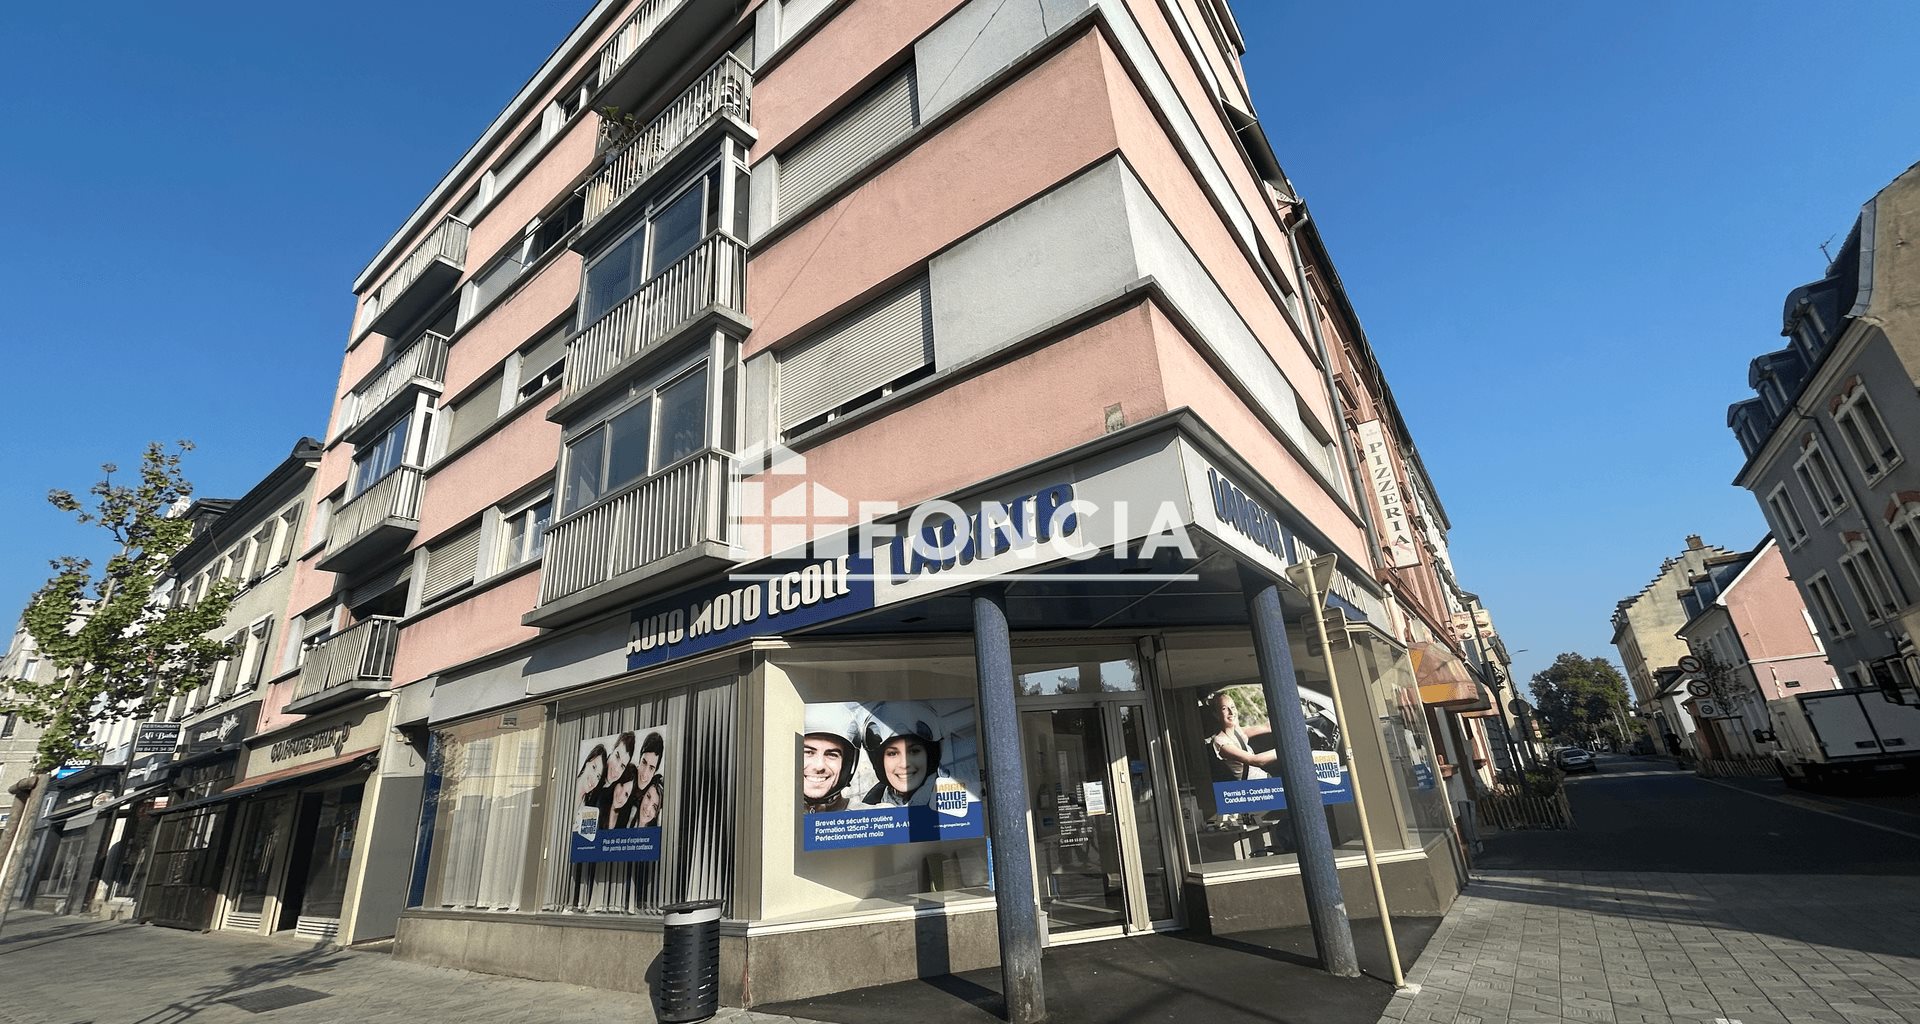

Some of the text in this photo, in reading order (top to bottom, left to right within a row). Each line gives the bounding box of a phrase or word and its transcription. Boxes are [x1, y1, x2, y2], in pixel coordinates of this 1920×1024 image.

[1369, 441, 1410, 547] PIZZERIA
[626, 608, 684, 656] AUTO
[689, 584, 761, 638] MOTO
[767, 554, 851, 616] ECOLE
[139, 731, 177, 740] Ali Baba
[271, 737, 312, 763] COIFFURE
[936, 791, 961, 801] AUTO
[1224, 794, 1274, 804] Conduite supervisée
[936, 801, 962, 810] MOTO
[845, 816, 870, 824] sécurité
[870, 815, 893, 823] routière
[815, 826, 846, 834] Formation
[873, 822, 894, 830] Permis
[815, 832, 868, 842] Perfectionnement
